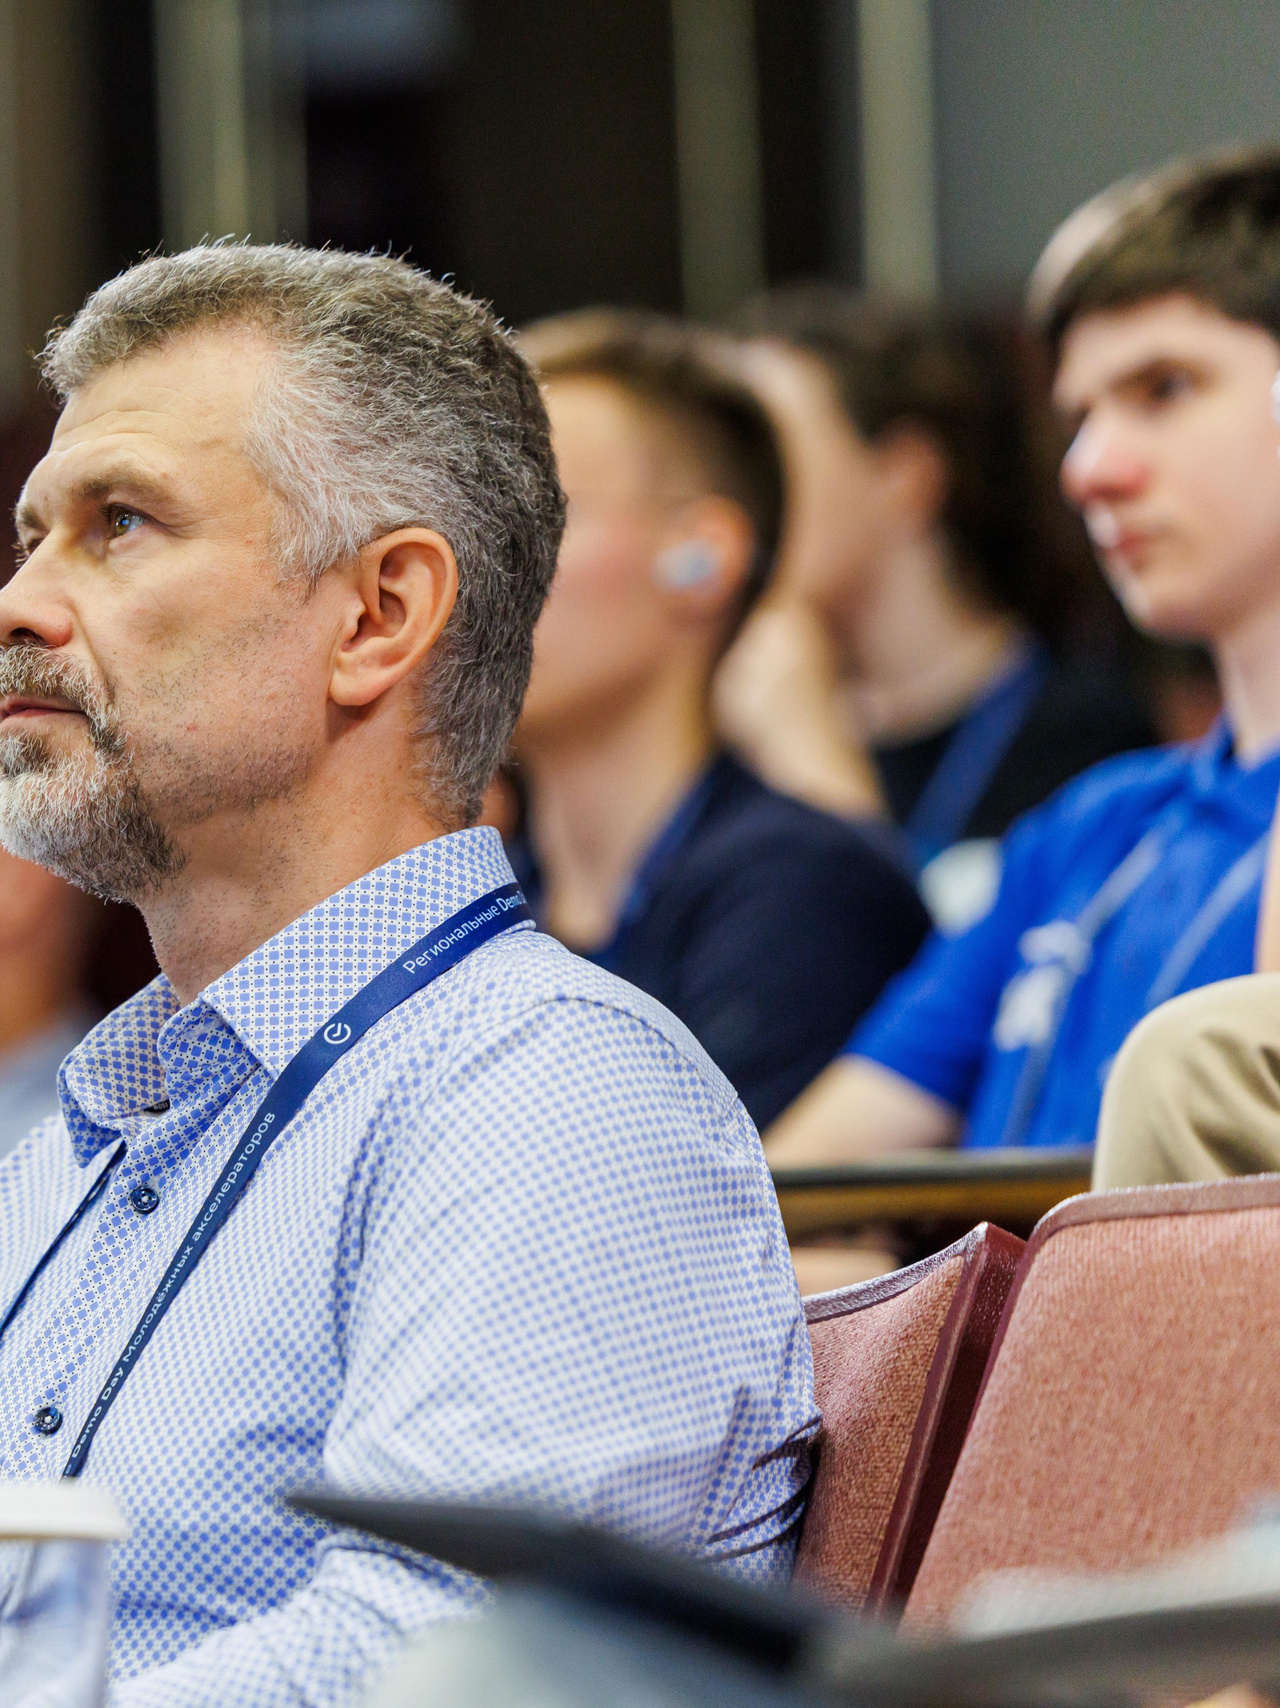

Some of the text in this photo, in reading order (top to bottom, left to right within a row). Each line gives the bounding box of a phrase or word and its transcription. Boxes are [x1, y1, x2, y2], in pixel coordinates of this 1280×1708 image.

[402, 904, 501, 974] Региональные
[72, 1112, 276, 1458] Demo Day Молодёжных акселераторов
